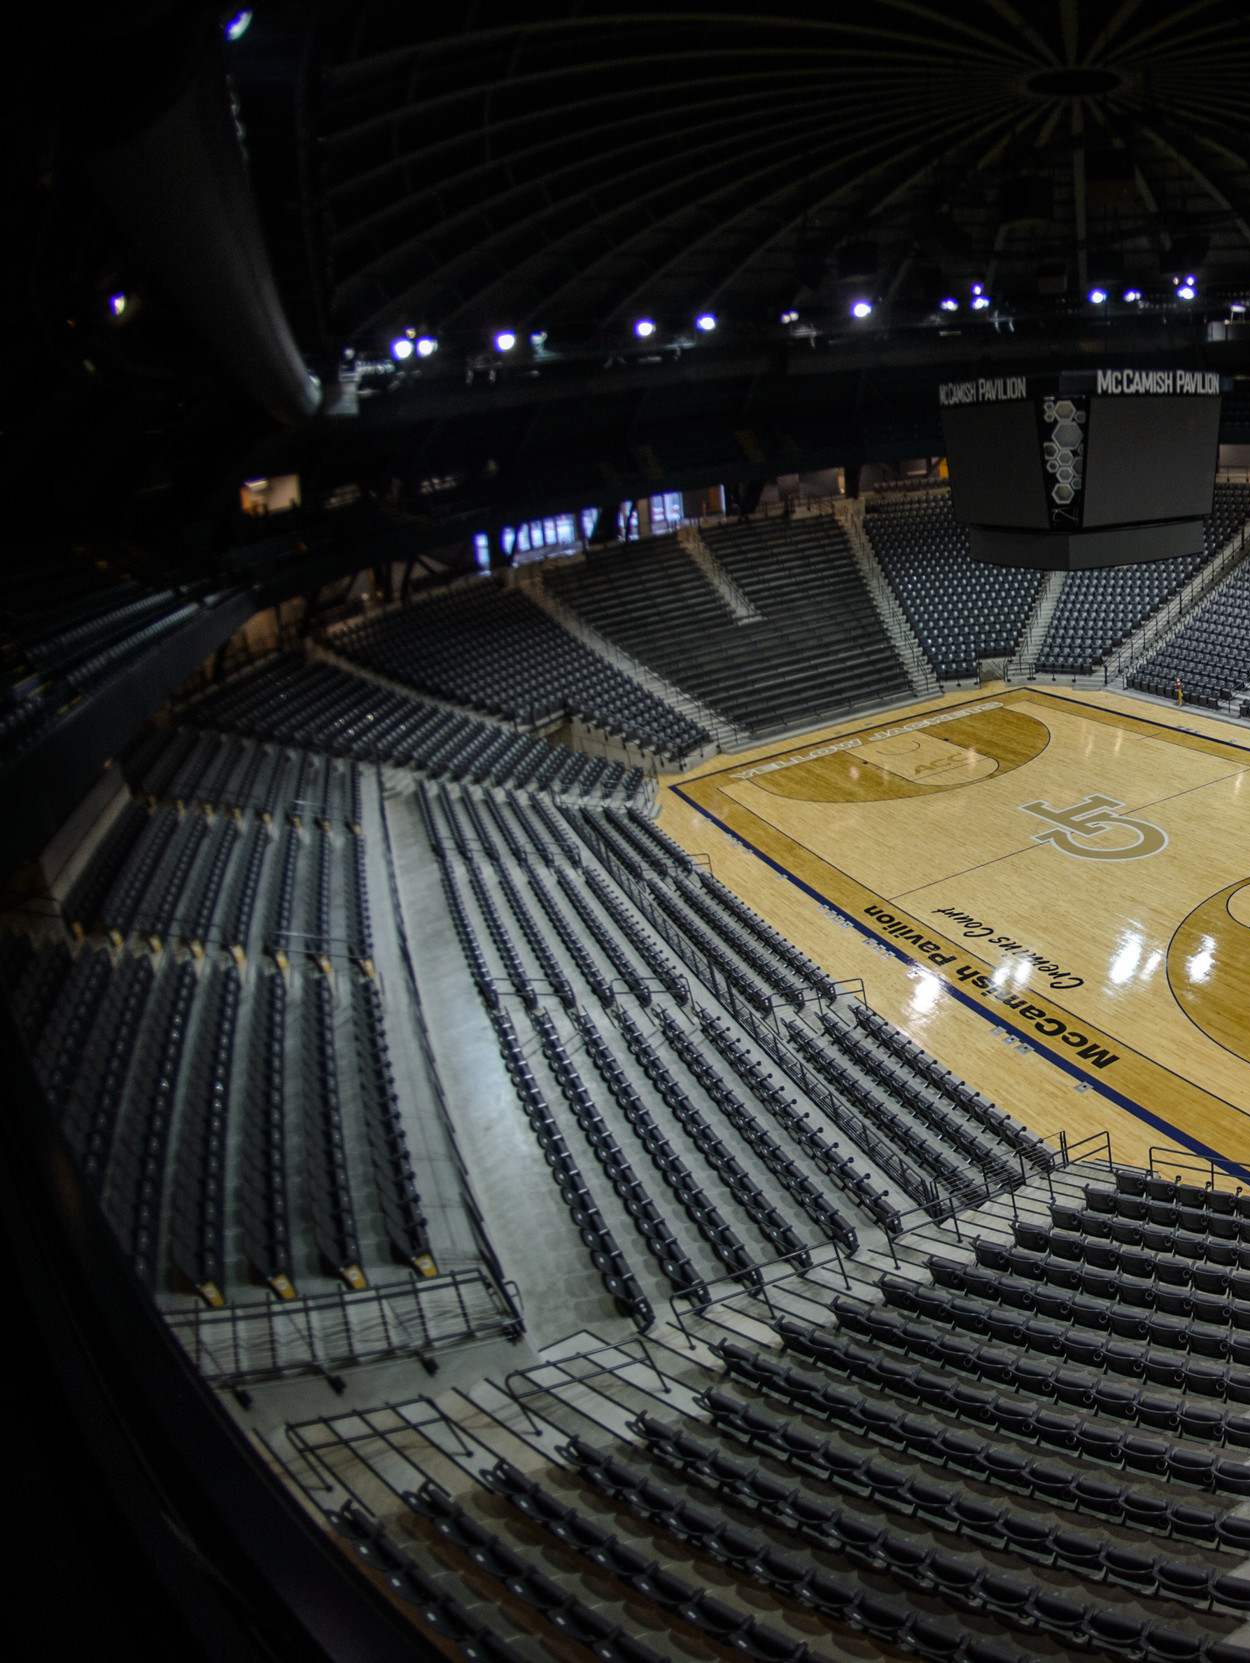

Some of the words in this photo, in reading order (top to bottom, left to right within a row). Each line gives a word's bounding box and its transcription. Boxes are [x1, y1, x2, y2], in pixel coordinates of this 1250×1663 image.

[978, 376, 1027, 402] PAVILION
[1176, 369, 1220, 395] PAVILION
[914, 752, 969, 775] ACC
[863, 905, 957, 966] Pavilion
[932, 907, 994, 938] Court
[956, 965, 1120, 1069] McCamish
